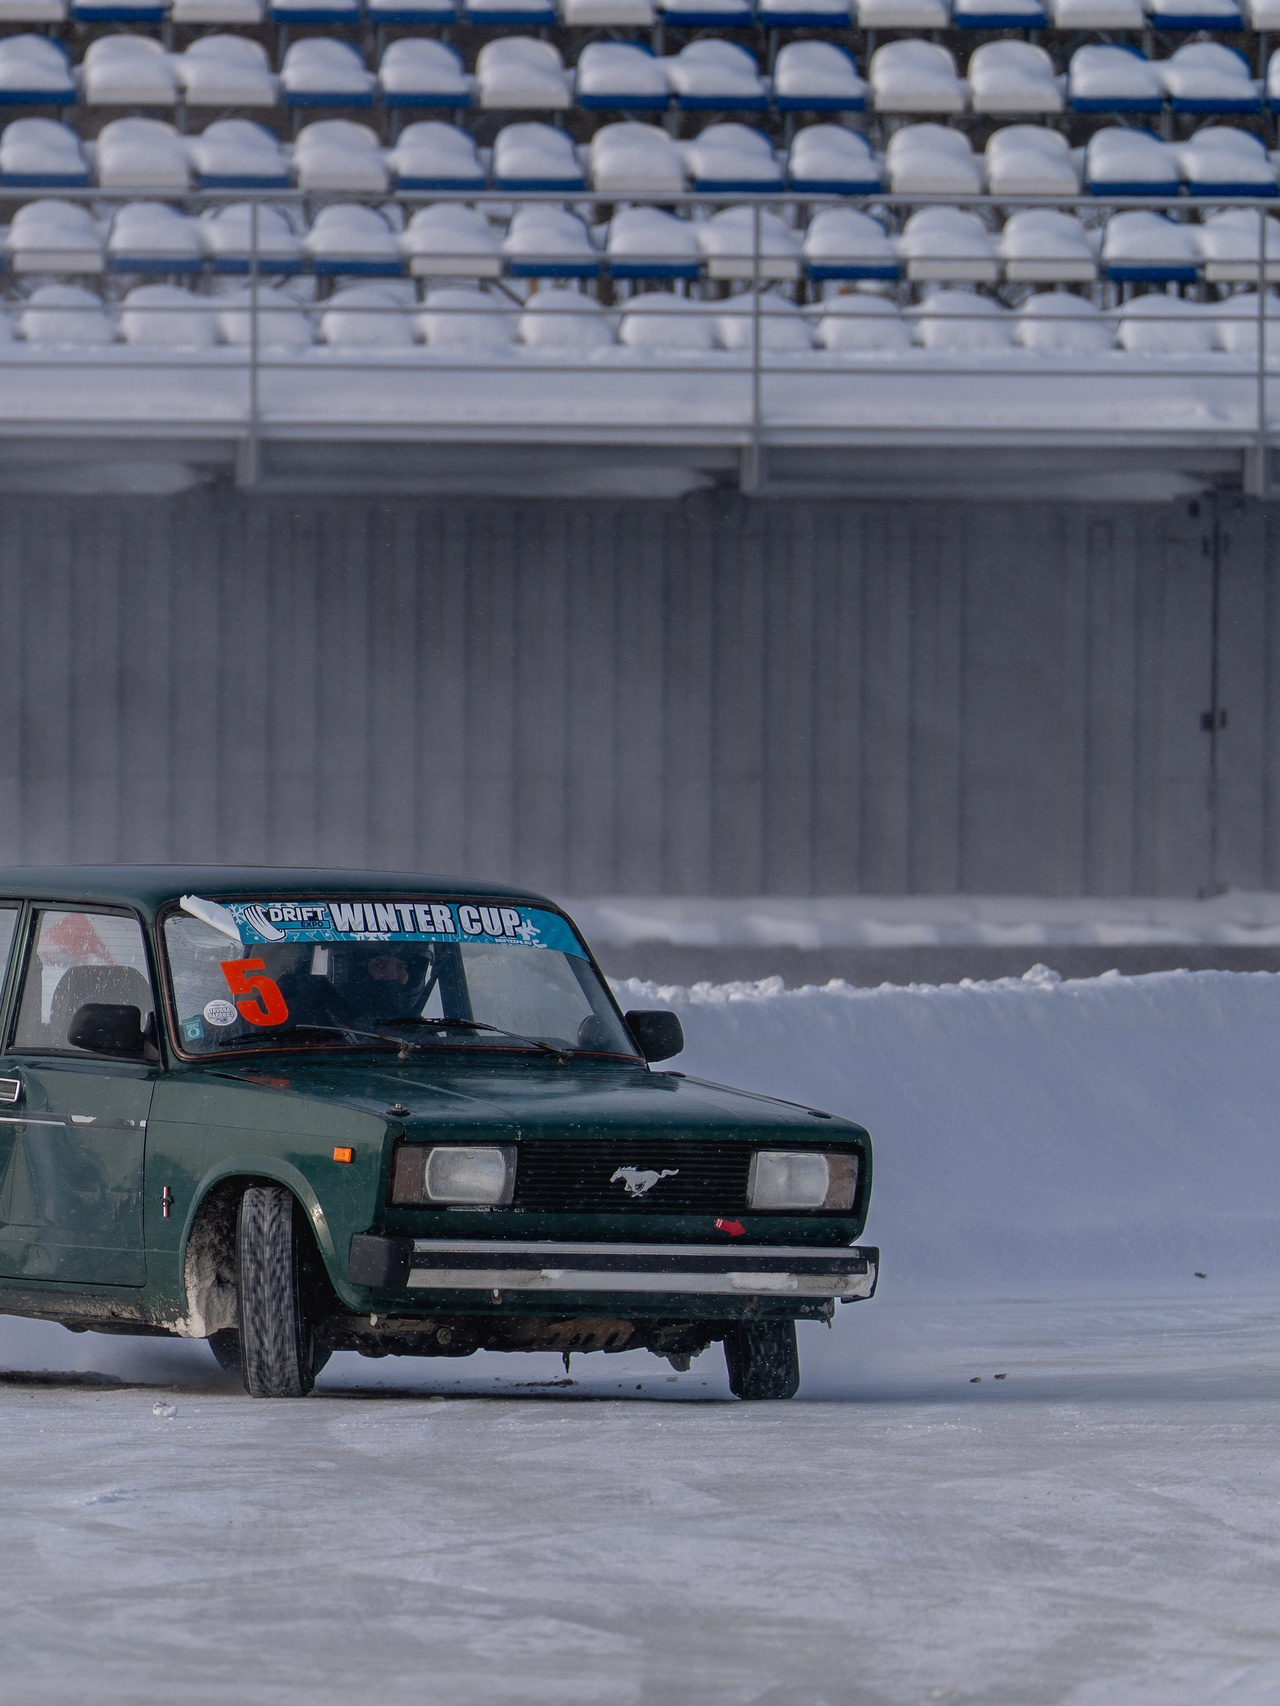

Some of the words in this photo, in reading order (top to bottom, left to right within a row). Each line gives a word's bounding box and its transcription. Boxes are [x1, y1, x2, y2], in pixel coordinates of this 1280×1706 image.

[269, 907, 326, 922] DRIFT
[328, 903, 456, 934] WINTER
[457, 905, 520, 937] CUP
[220, 958, 289, 1026] 5
